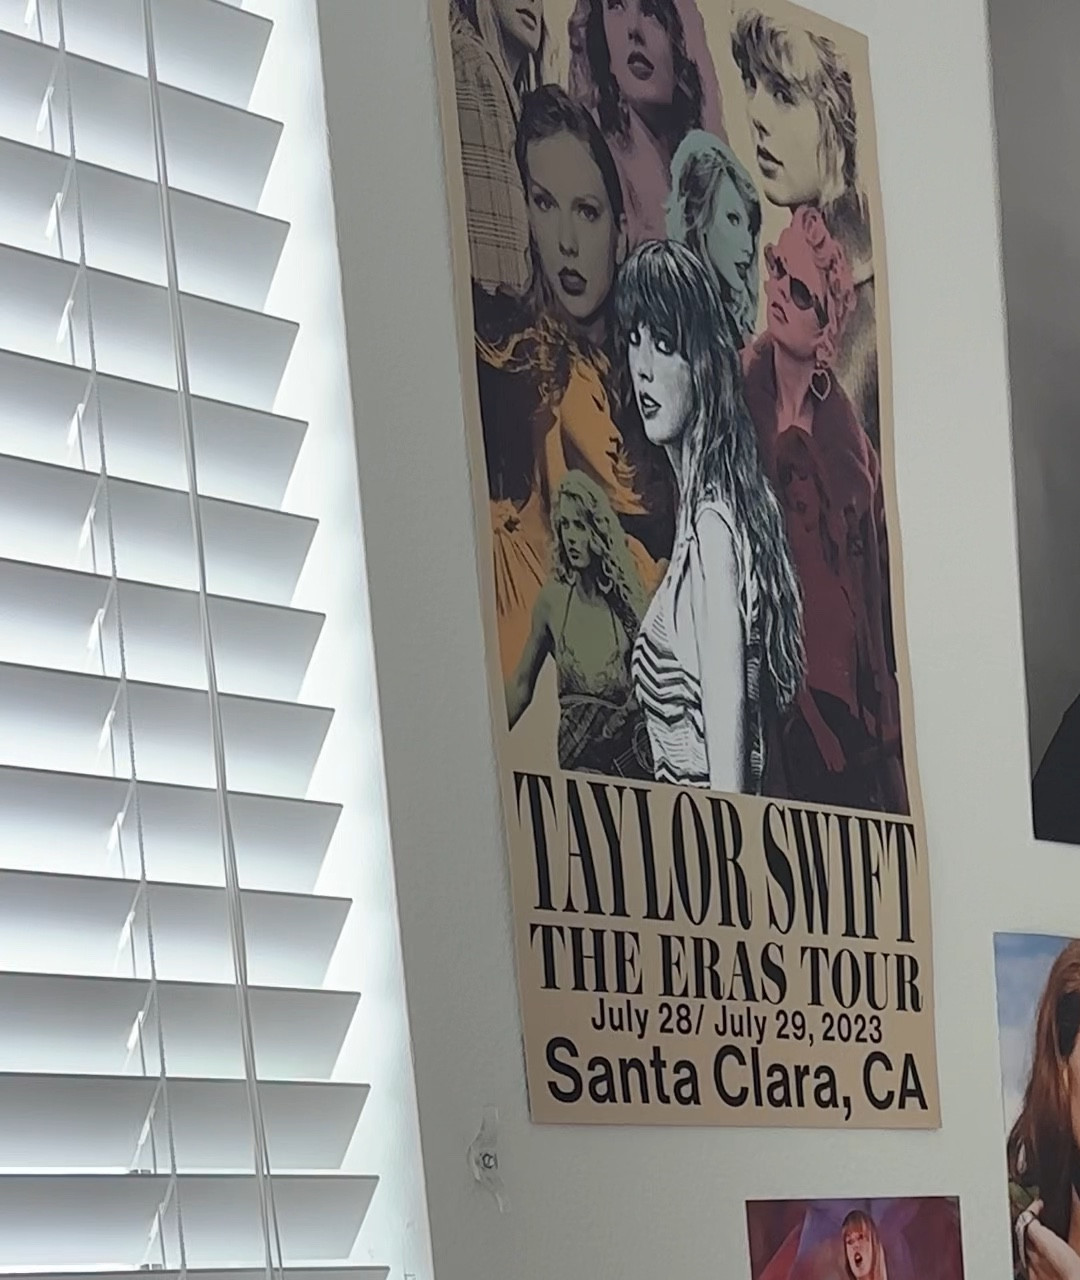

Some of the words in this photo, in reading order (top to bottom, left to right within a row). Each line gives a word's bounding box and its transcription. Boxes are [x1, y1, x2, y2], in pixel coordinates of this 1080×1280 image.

[513, 772, 752, 931] TAYLOR
[762, 802, 919, 944] SWIFT
[530, 923, 643, 995] THE
[658, 934, 788, 1005] ERAS
[800, 945, 924, 1013] TOUR
[591, 998, 648, 1039] July
[657, 1002, 705, 1036] 28/
[714, 1008, 768, 1045] July
[775, 1010, 815, 1045] 29,
[821, 1013, 884, 1044] 2023
[545, 1036, 702, 1107] Santa
[713, 1045, 853, 1121] Clara,
[862, 1051, 928, 1111] CA
